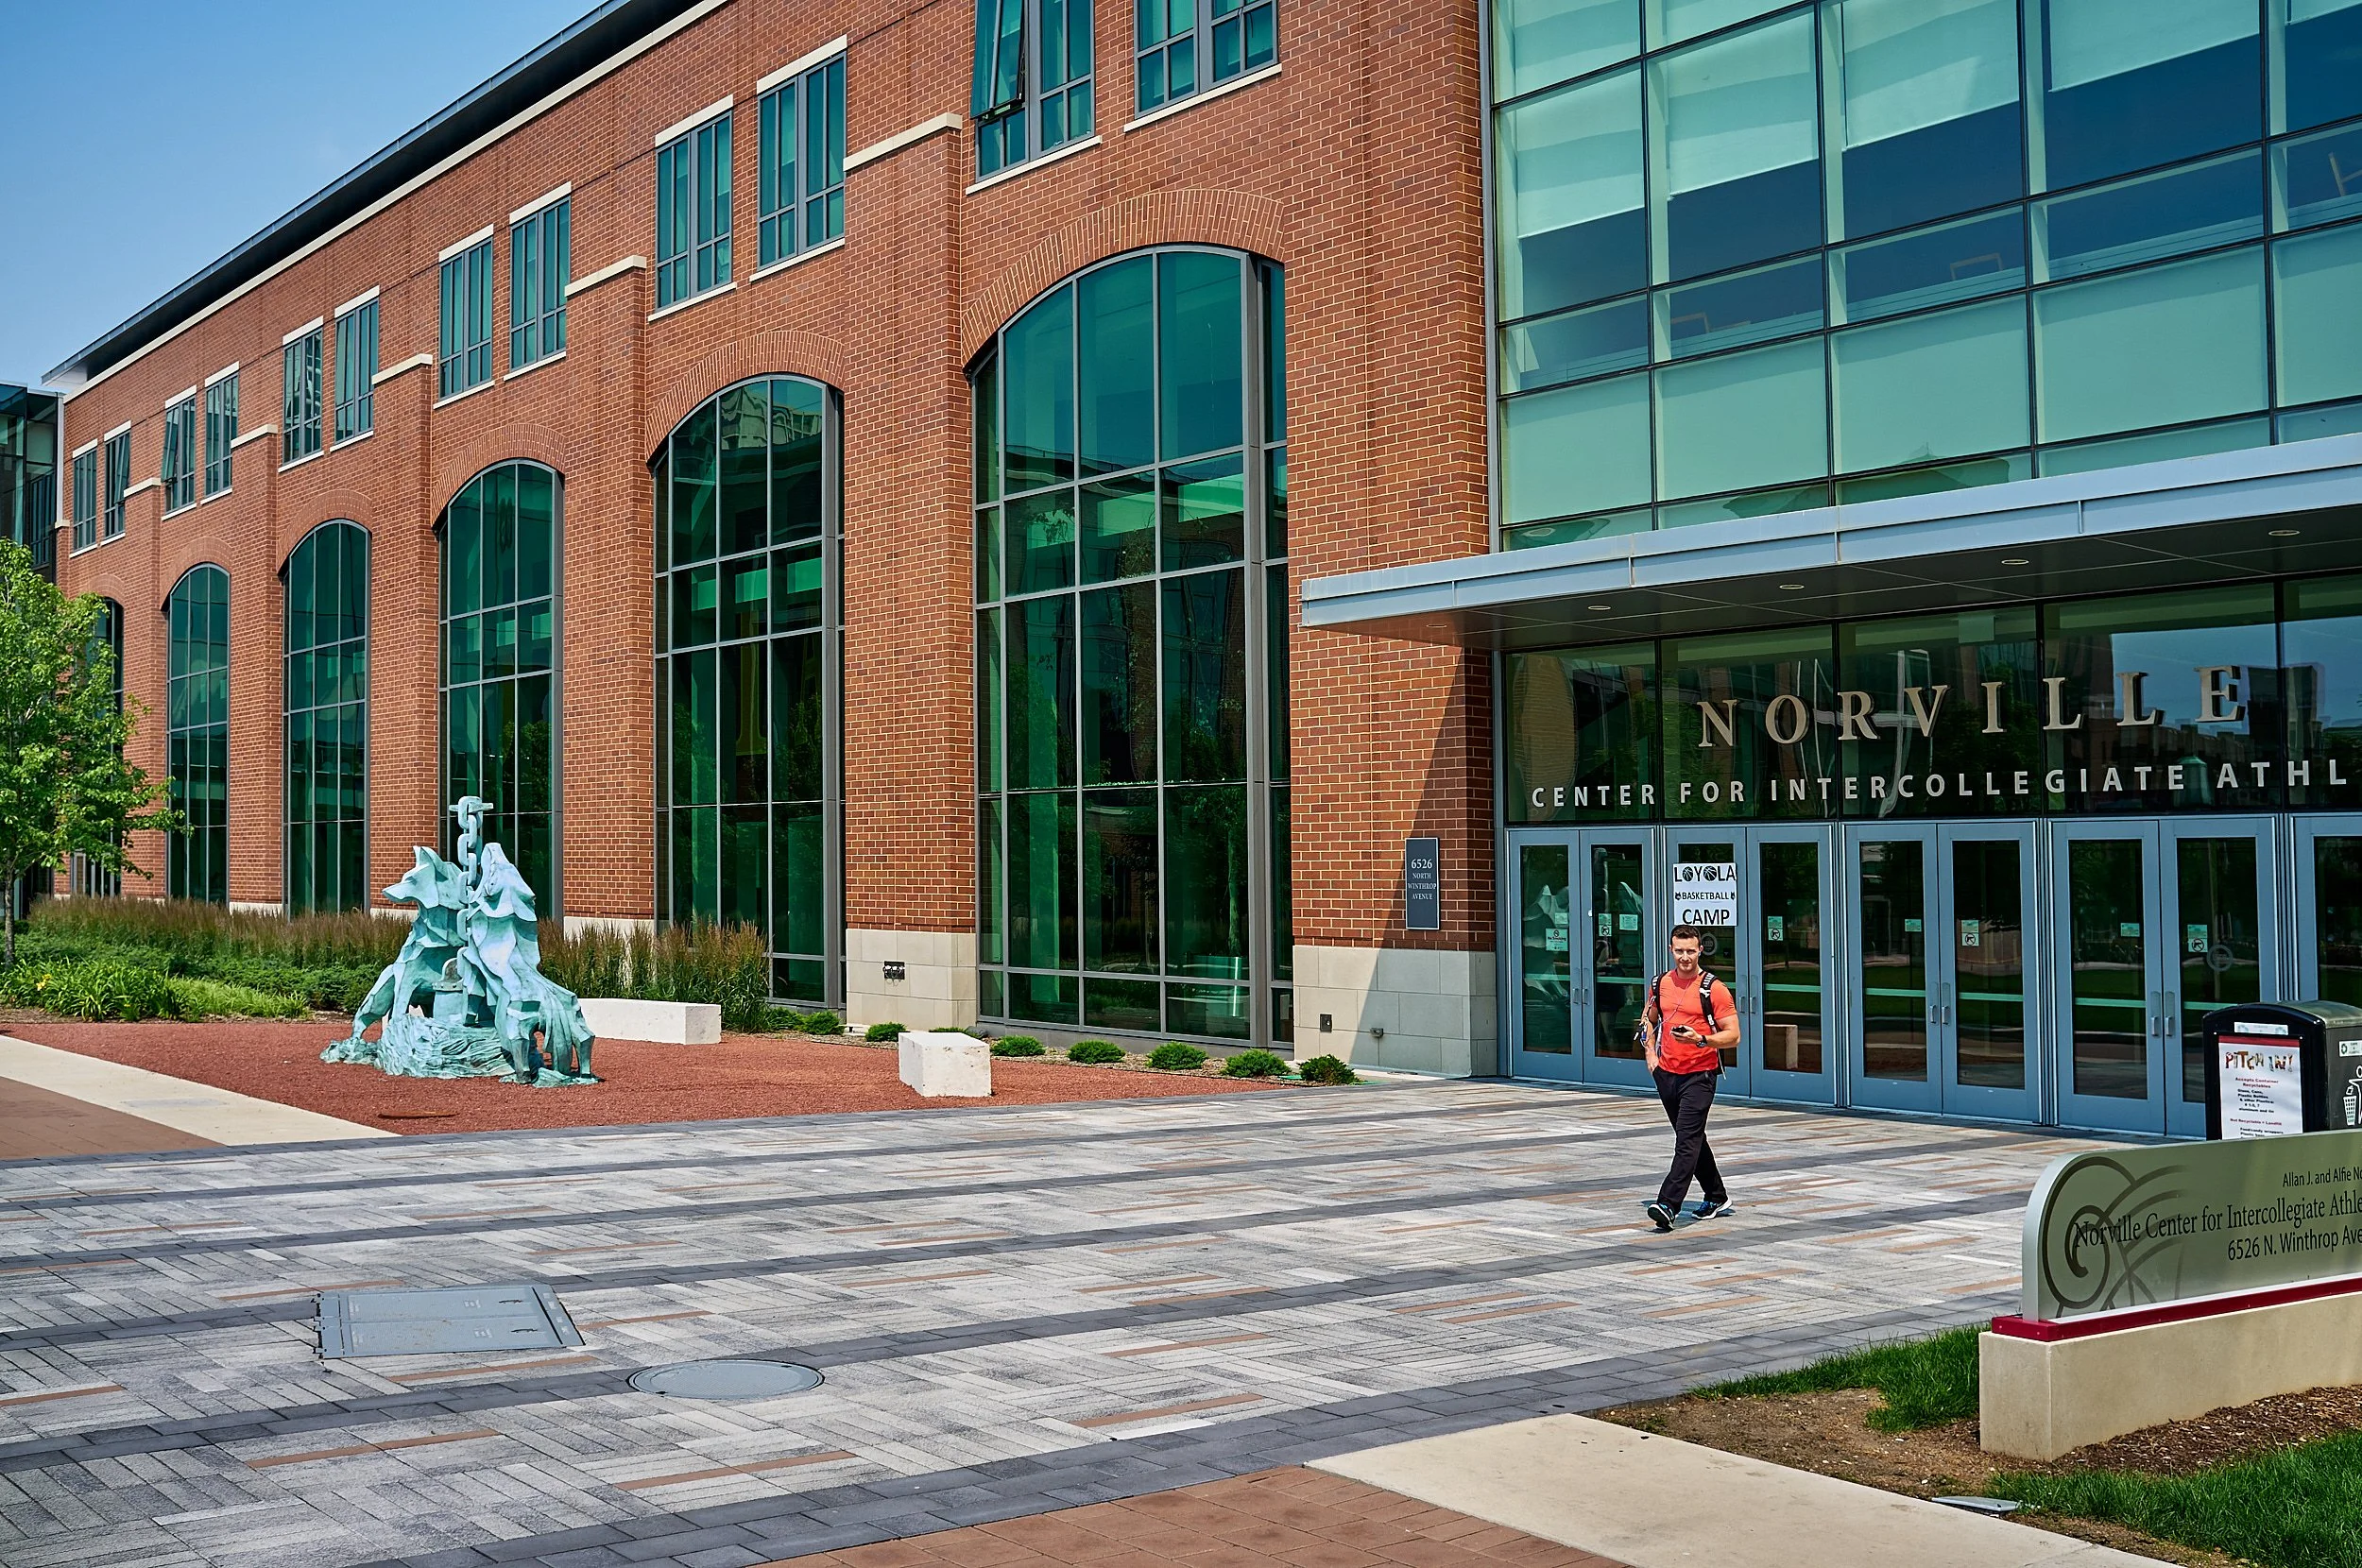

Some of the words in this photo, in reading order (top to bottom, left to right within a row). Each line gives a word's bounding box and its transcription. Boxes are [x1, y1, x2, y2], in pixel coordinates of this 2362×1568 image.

[1699, 665, 2247, 749] NORVILLE
[1532, 783, 1654, 808] CENTER
[1680, 780, 1745, 804] FOR
[1771, 764, 2184, 802] INTERCOLLEGIATE
[2217, 758, 2347, 789] ATHL
[1412, 859, 1432, 868] 6526
[1674, 865, 1736, 882] LOYOLA
[1682, 892, 1729, 900] BASKETBALL
[1682, 909, 1730, 925] CAMP
[2225, 1050, 2264, 1069] PITCH
[2283, 1171, 2305, 1187] Allan
[2306, 1170, 2313, 1185] J.
[2315, 1167, 2331, 1185] and
[2333, 1167, 2352, 1183] Alfie
[2073, 1215, 2141, 1248] Norville
[2145, 1212, 2198, 1239] Center
[2201, 1205, 2223, 1232] for
[2227, 1197, 2325, 1229] Intercollegiate
[2228, 1236, 2260, 1261] 6526
[2264, 1234, 2277, 1256] N.
[2280, 1228, 2339, 1253] Winthrop
